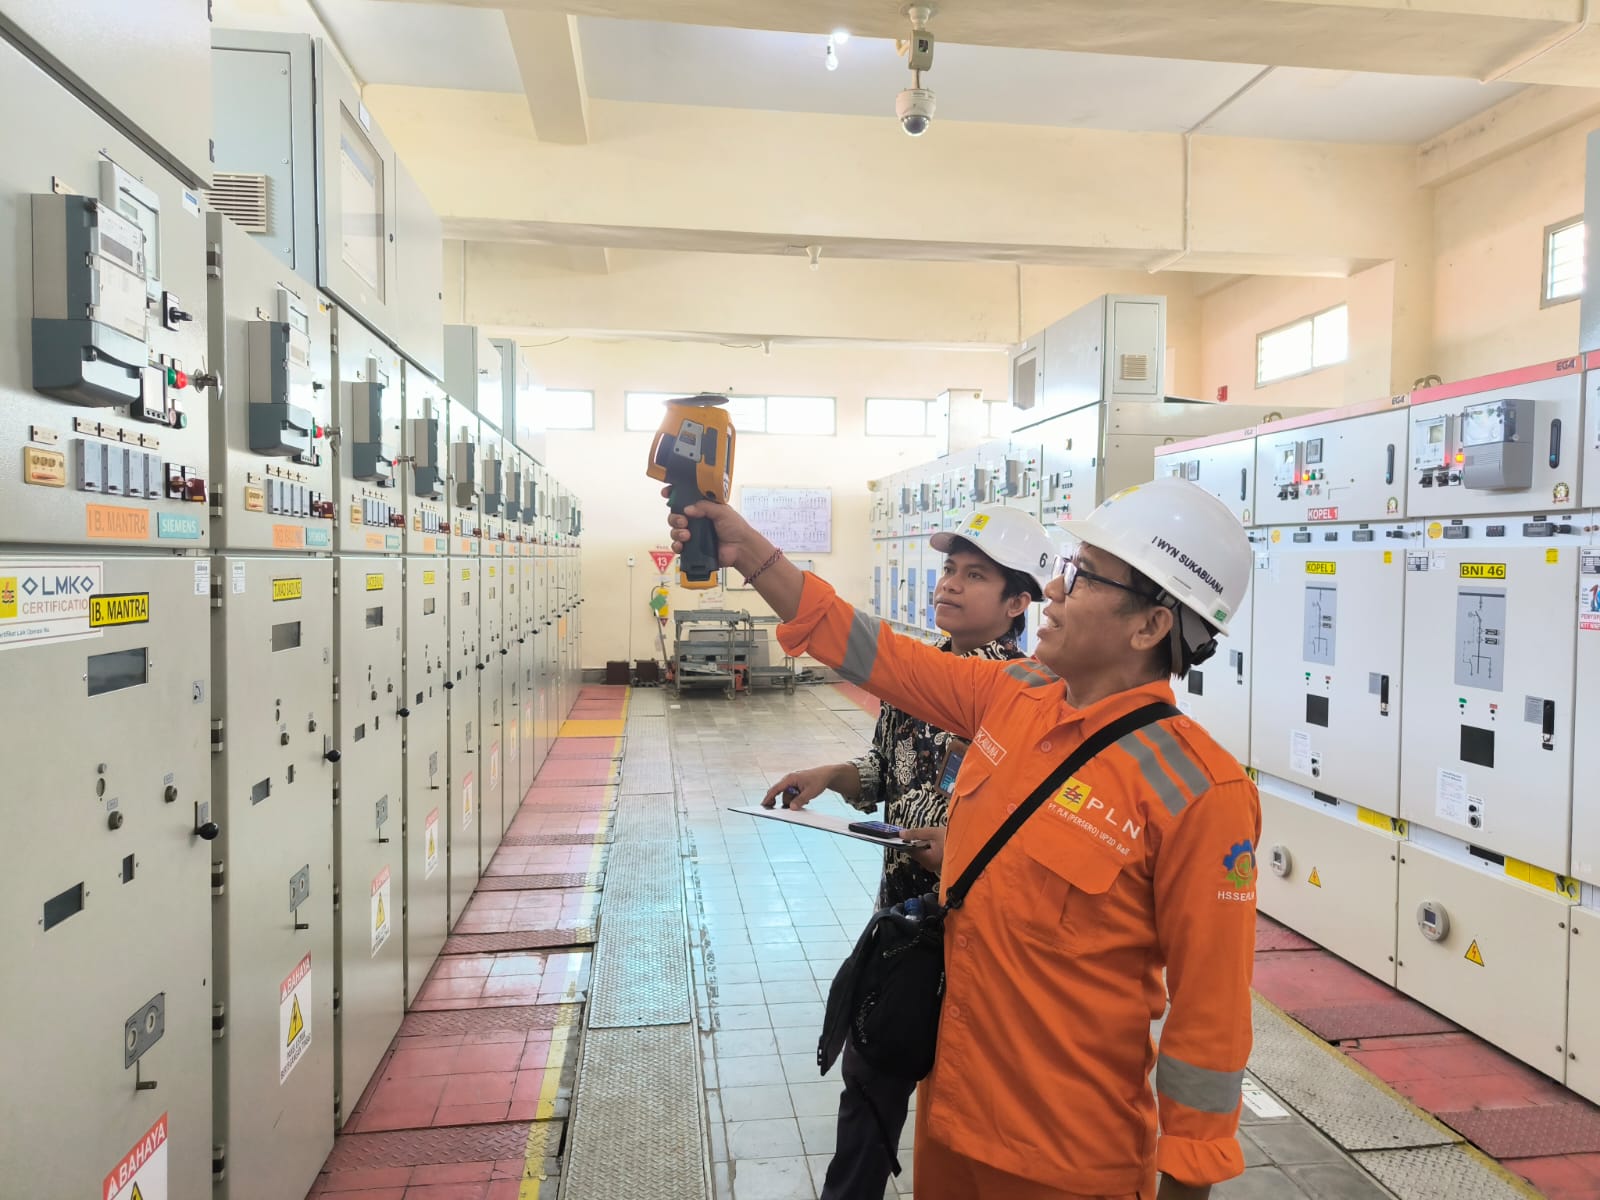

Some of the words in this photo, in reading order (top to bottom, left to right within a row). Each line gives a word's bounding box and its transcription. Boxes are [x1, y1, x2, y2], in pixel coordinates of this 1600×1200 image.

[107, 511, 147, 533] MANTRA
[1308, 509, 1332, 520] KOPEL
[162, 519, 197, 533] SIEMENS
[1040, 552, 1048, 568] 6
[1157, 538, 1180, 558] WYN
[1178, 553, 1224, 595] SUKABUANA
[1307, 563, 1328, 573] KOPEL
[1462, 565, 1484, 576] BNI
[1487, 565, 1504, 576] 46
[22, 599, 89, 615] CERTIFICATIO
[107, 599, 147, 621] MANTRA
[1086, 796, 1141, 840] PLN
[119, 1122, 165, 1188] BAHAYA
